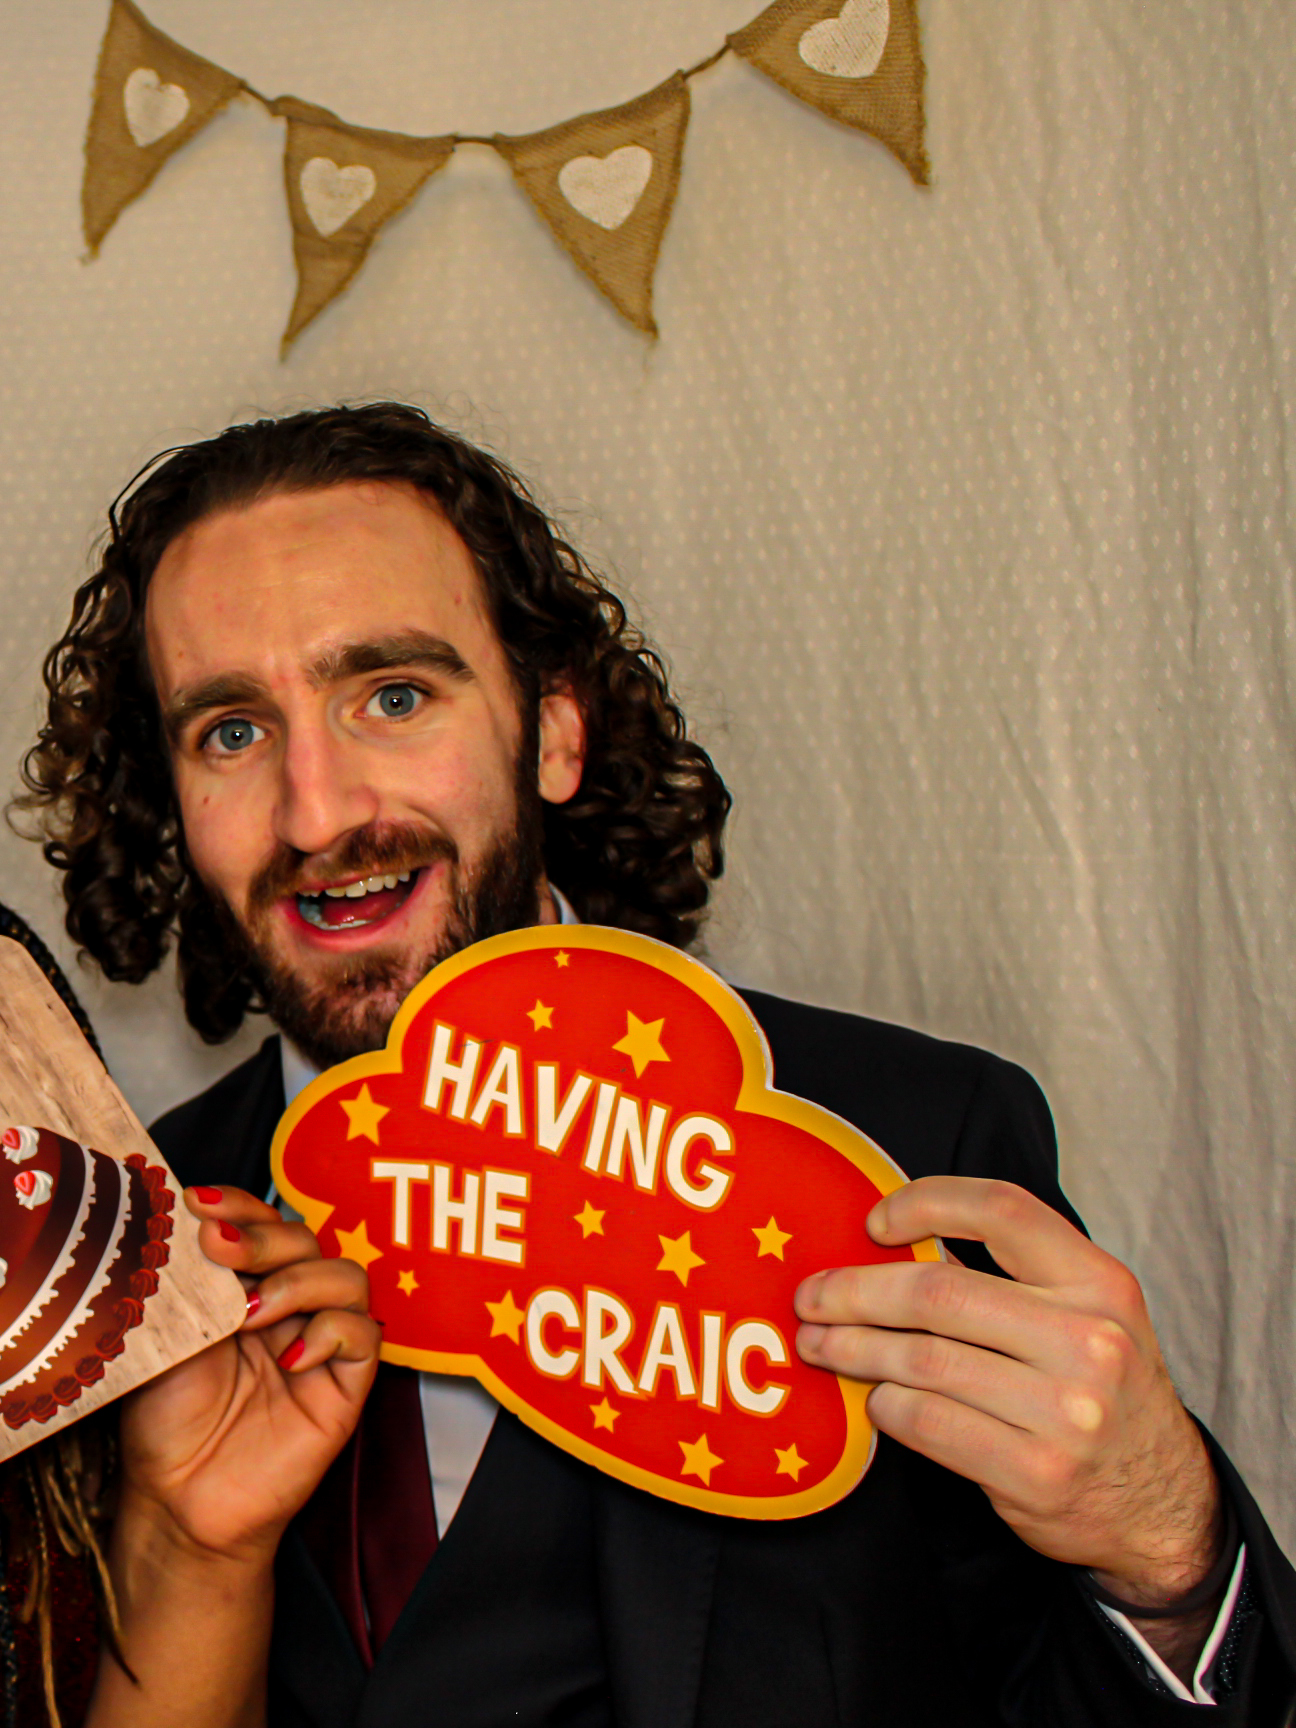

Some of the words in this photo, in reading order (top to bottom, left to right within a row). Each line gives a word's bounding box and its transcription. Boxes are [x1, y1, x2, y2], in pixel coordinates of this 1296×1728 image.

[423, 1024, 733, 1209] HAVING
[371, 1161, 529, 1266] THE
[526, 1288, 788, 1415] CRAIC
